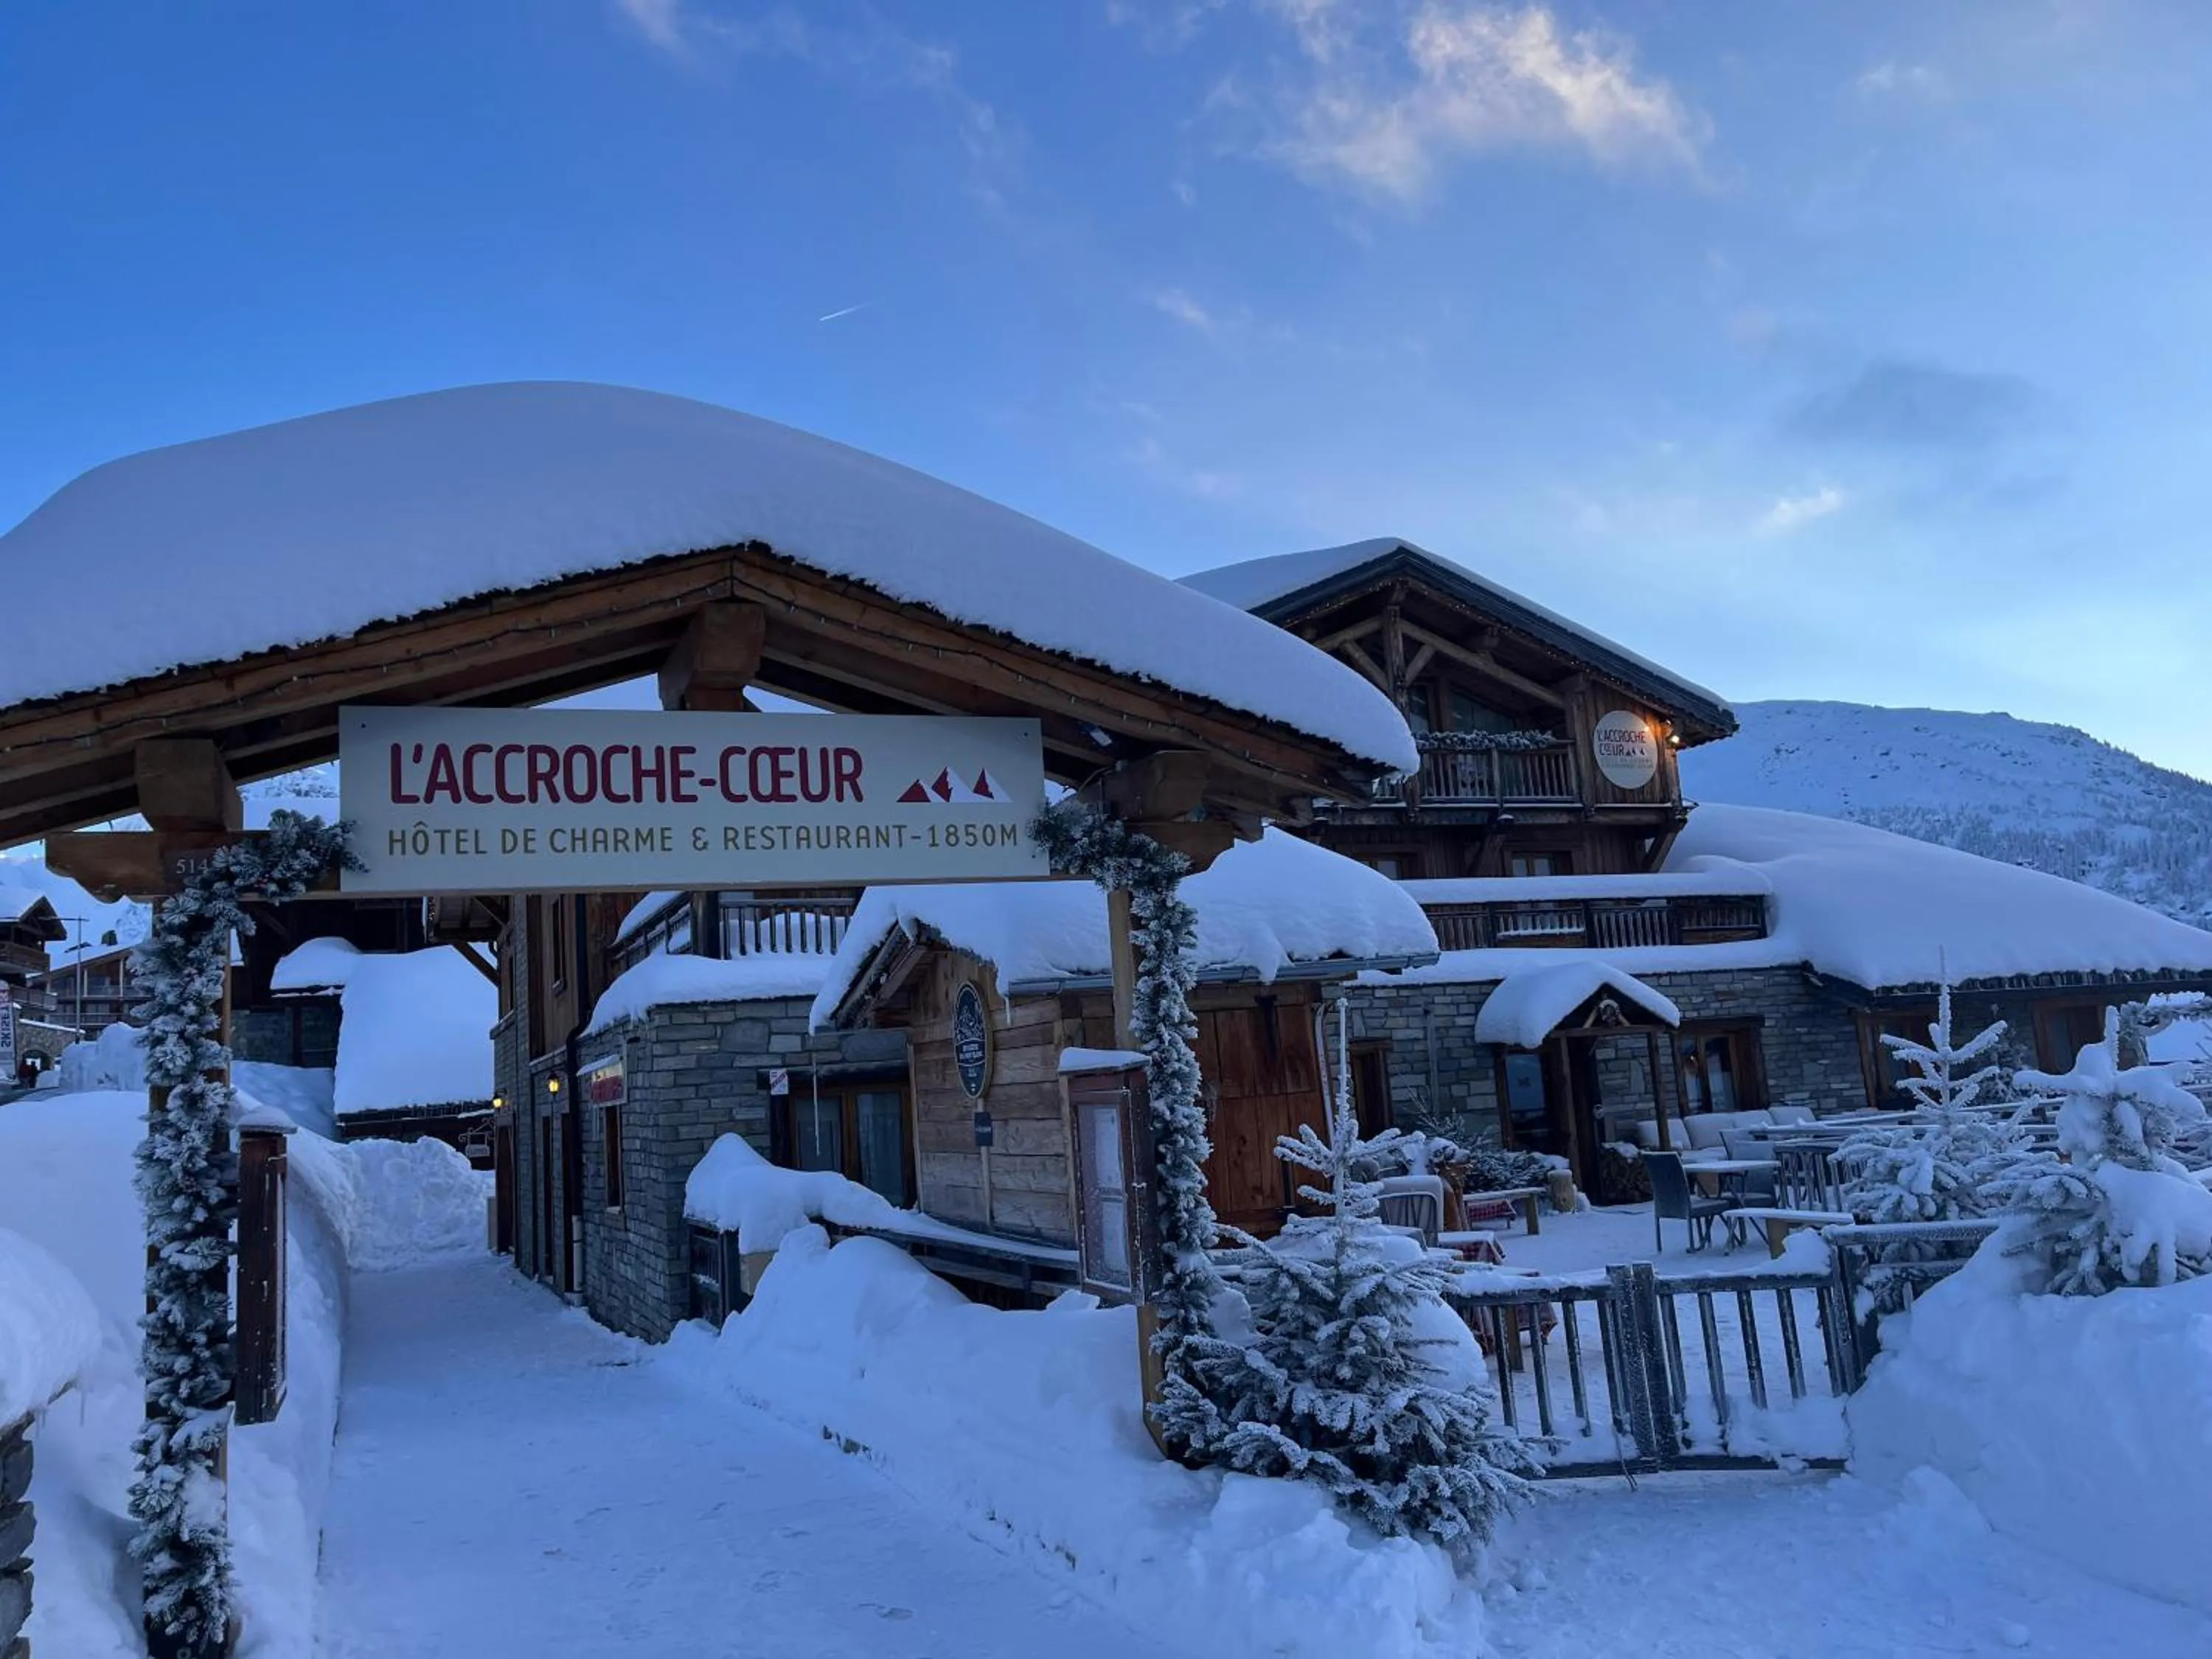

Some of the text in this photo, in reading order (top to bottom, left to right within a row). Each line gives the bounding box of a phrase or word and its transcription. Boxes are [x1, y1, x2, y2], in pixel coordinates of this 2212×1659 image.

[1596, 728, 1646, 744] L'ACCROCHE
[390, 742, 864, 804] L'ACCROCHE-CŒUR
[388, 821, 1018, 856] HÔTEL DE CHARME & RESTAURANT-1850M
